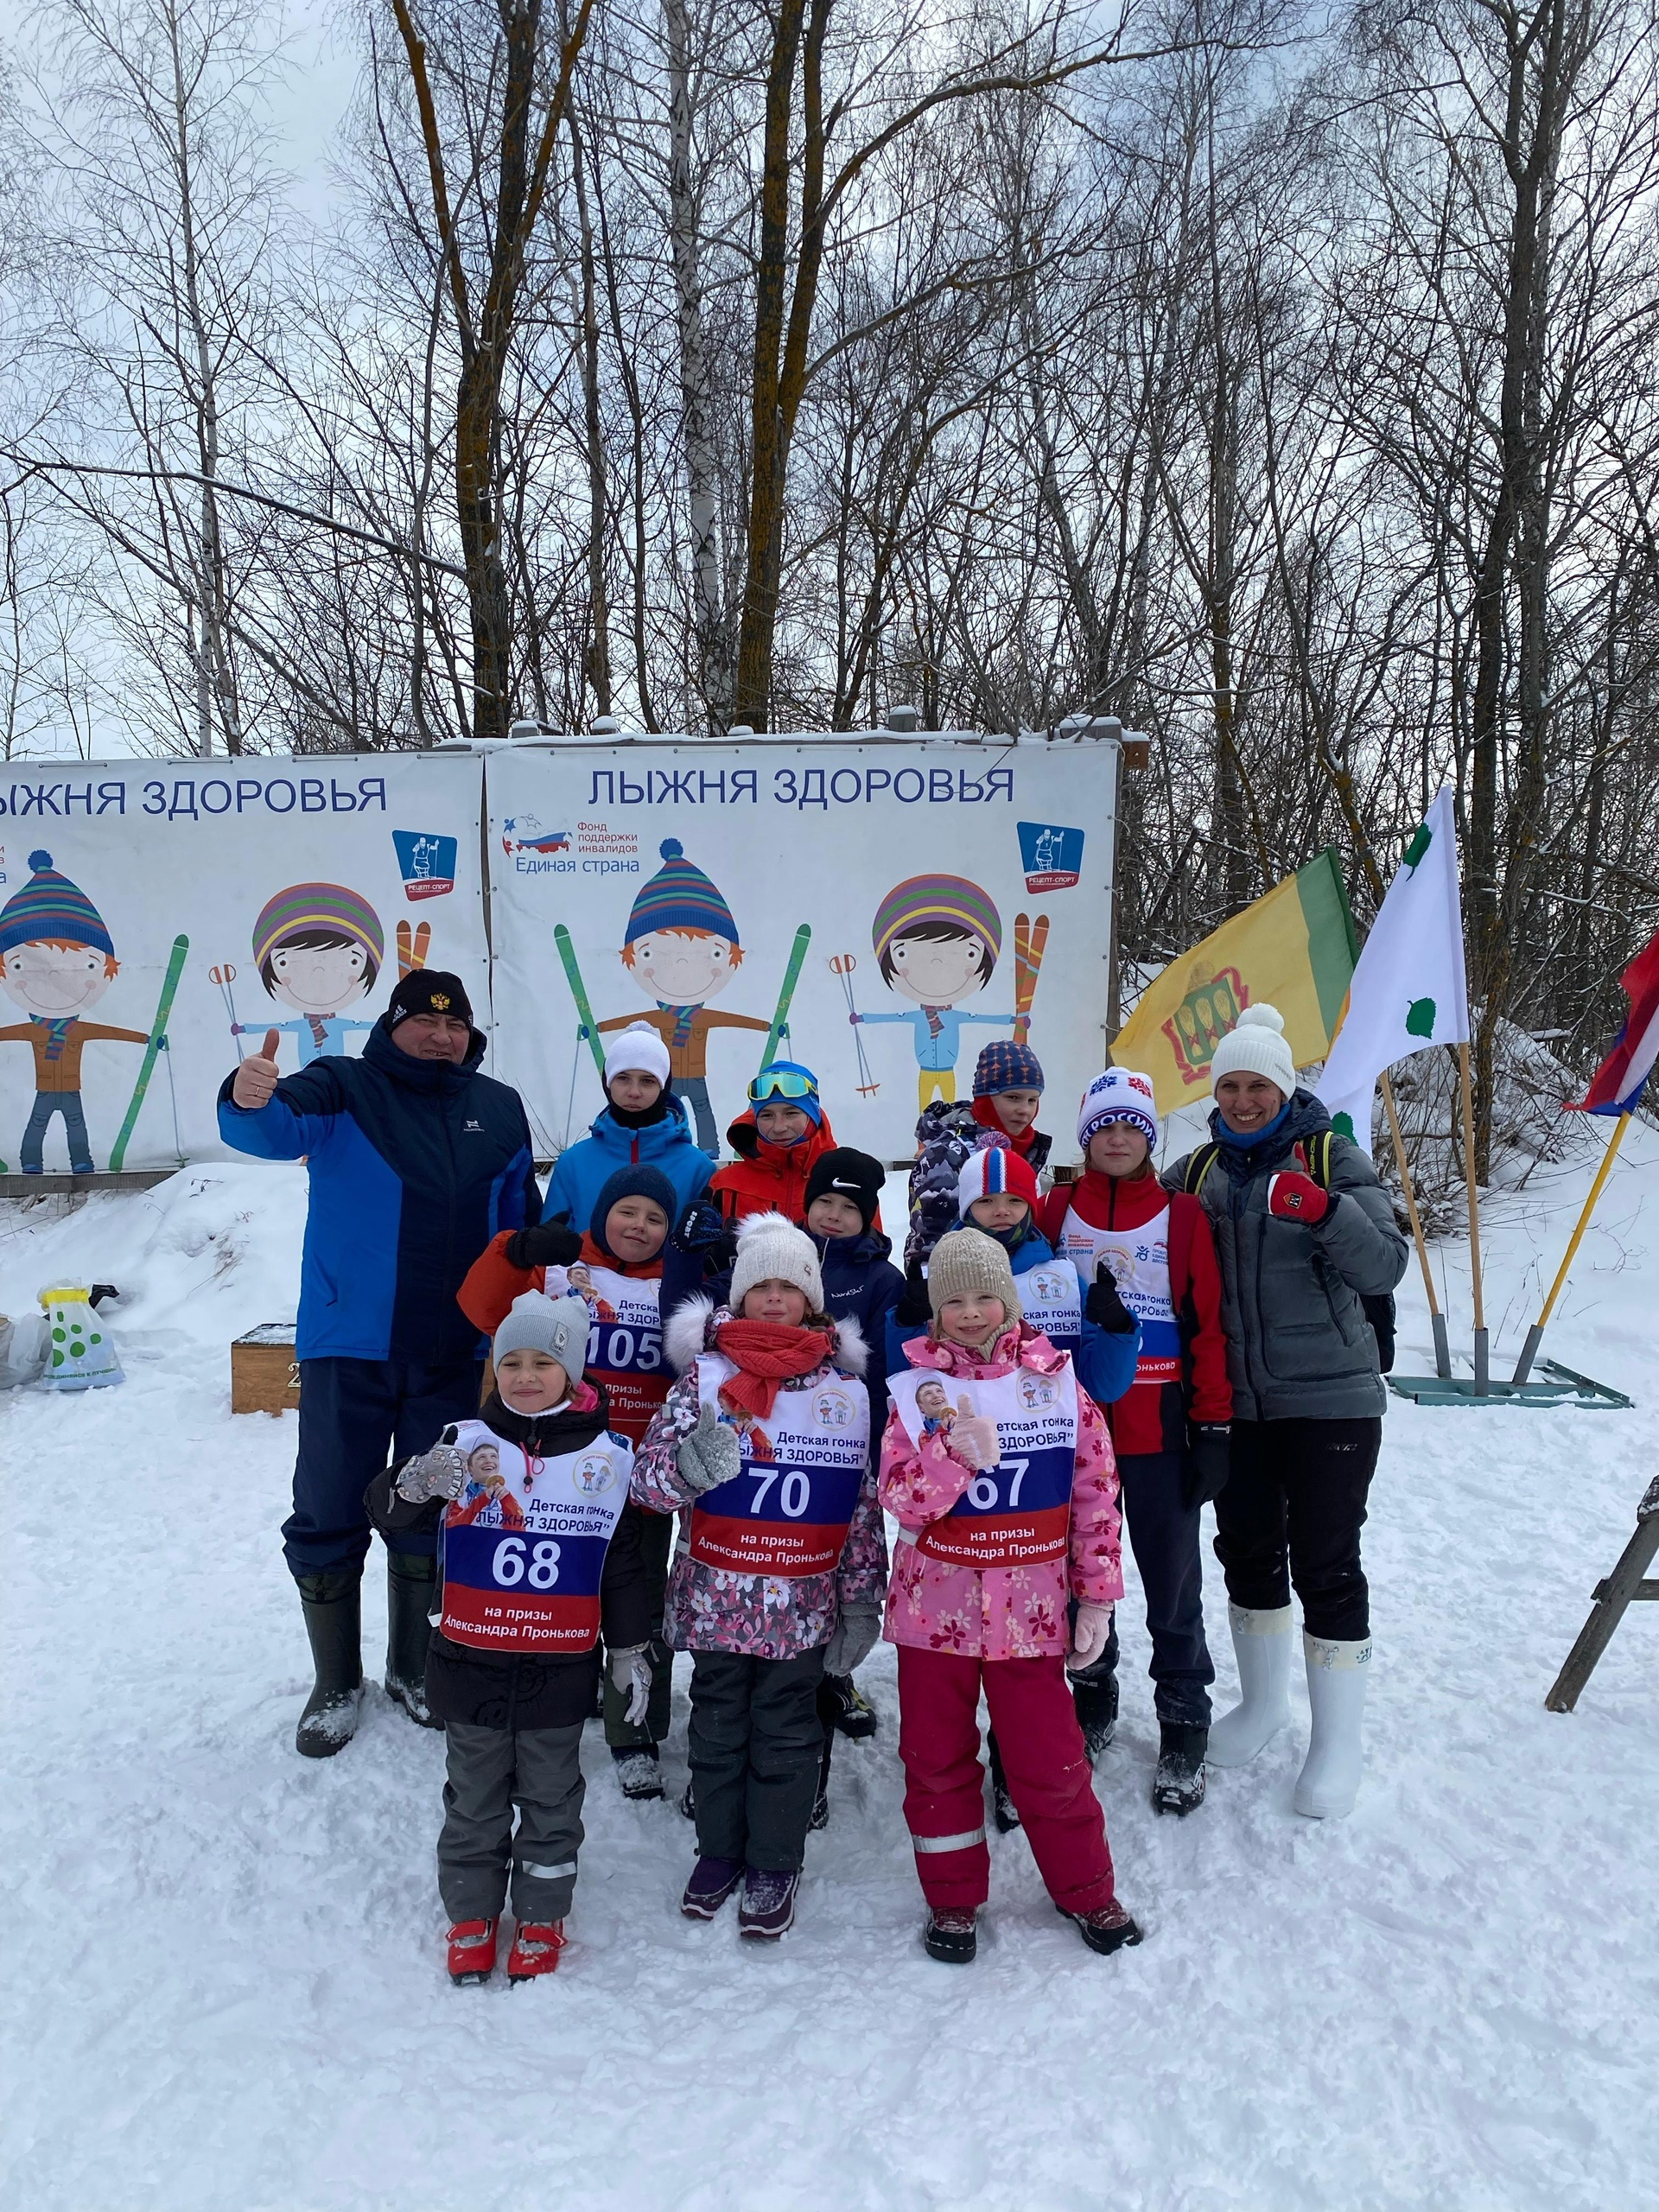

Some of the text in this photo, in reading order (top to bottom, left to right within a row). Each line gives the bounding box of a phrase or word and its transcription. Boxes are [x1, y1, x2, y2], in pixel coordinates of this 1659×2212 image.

[588, 768, 1014, 810] ЛЫЖНЯ ЗДОРОВЬЯ
[0, 778, 386, 821] ЫЖНЯ ЗДОРОВЬЯ
[577, 822, 607, 831] Фонд
[578, 834, 638, 843] поддержки
[578, 845, 639, 854] инвалидов
[516, 857, 639, 876] Единая страна
[1091, 1112, 1153, 1138] РОССИИ
[683, 1211, 697, 1238] SPORT
[1116, 1291, 1147, 1301] тская
[619, 1300, 659, 1313] Детска
[1023, 1311, 1048, 1319] ская
[588, 1311, 660, 1325] ЫЖНЯ ЗДОР
[587, 1326, 663, 1370] 105
[287, 1362, 302, 1388] 2
[1136, 1362, 1176, 1372] онькова
[605, 1383, 642, 1395] призы
[619, 1397, 664, 1410] Пронько
[996, 1417, 1074, 1432] етская гонка
[777, 1431, 866, 1449] Детская гонка
[739, 1444, 783, 1459] ЫЖНЯ
[747, 1466, 810, 1517] 70
[966, 1458, 1030, 1510] 67
[529, 1498, 615, 1521] Детская гонка
[740, 1534, 804, 1548] на призы
[970, 1527, 1035, 1543] на призы
[698, 1535, 834, 1565] Александра Пронькова
[925, 1535, 1065, 1560] Александра Пронькова
[492, 1536, 562, 1590] 68
[484, 1606, 552, 1622] на призы
[443, 1613, 590, 1641] Александра Пронькова
